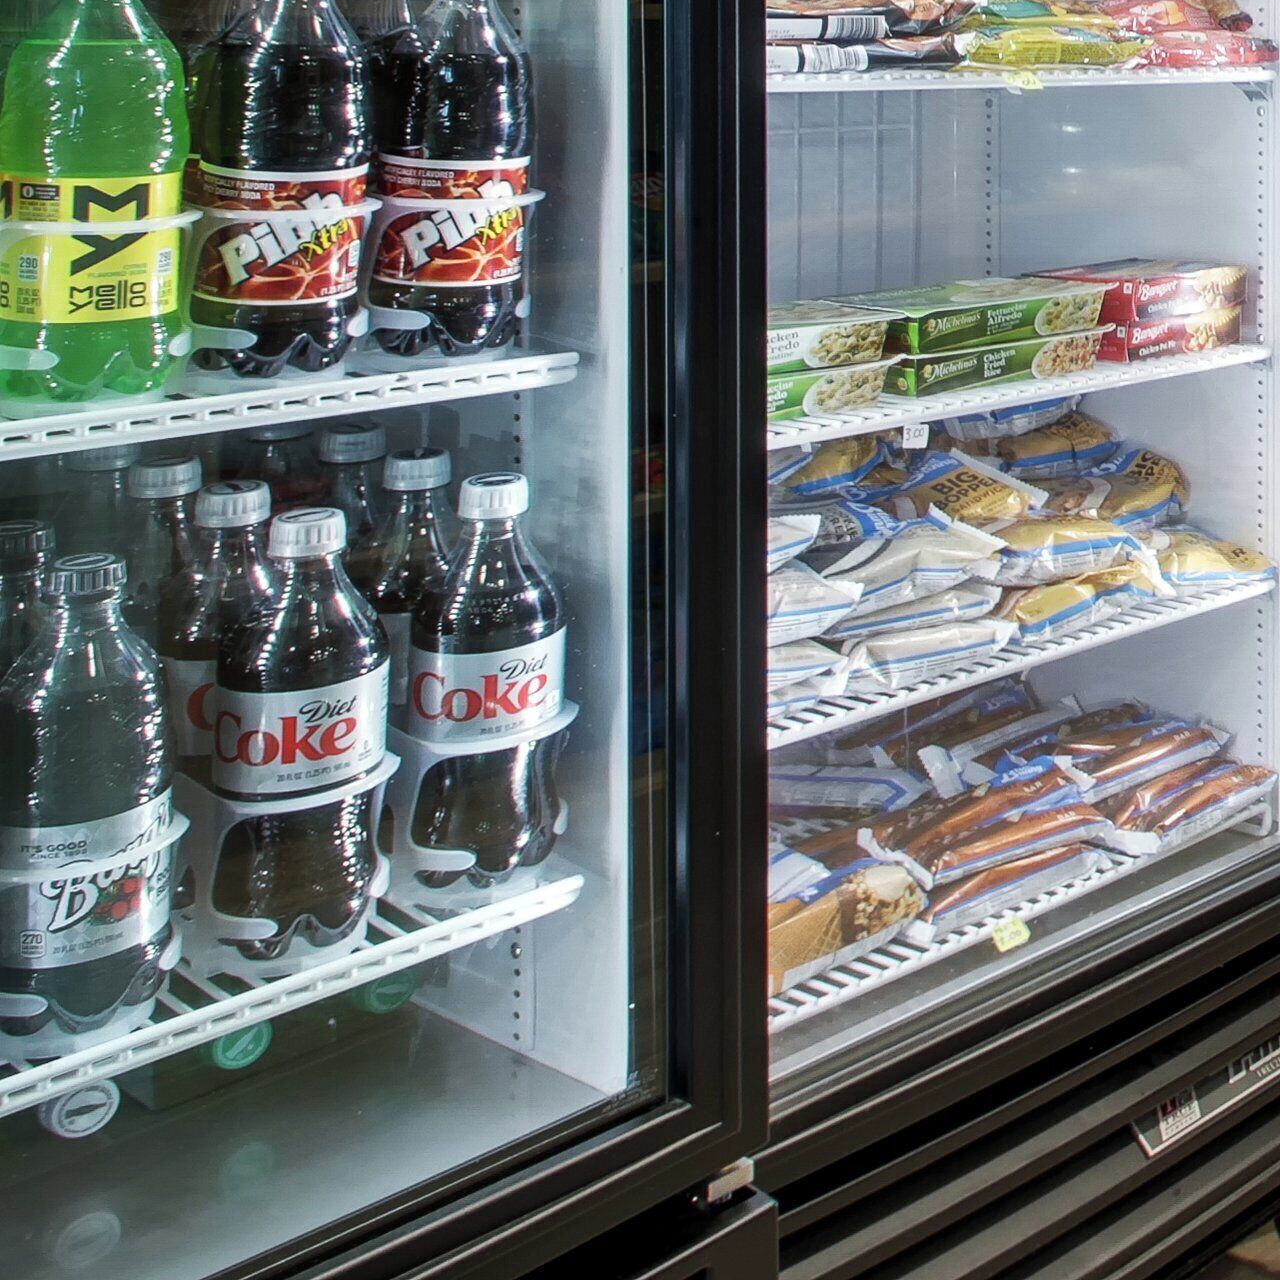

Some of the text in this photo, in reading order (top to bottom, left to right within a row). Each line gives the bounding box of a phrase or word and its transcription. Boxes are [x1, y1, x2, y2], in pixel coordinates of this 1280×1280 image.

[418, 170, 455, 179] FLAVORED
[236, 181, 276, 191] FLAVORED
[421, 178, 443, 188] SODA
[240, 190, 263, 200] SODA
[19, 256, 39, 270] 290
[1140, 280, 1178, 302] Banquet
[986, 302, 1028, 318] Fettuccine
[986, 310, 1024, 325] Alfredo
[934, 311, 982, 333] Michelina's
[1131, 322, 1169, 344] Banquet
[983, 348, 1017, 364] Chicken
[930, 357, 978, 379] Michelina's
[983, 358, 1007, 371] Fried
[983, 367, 1002, 379] Rice
[929, 470, 979, 495] BIG
[499, 652, 549, 681] Diet
[413, 672, 548, 723] Coke
[299, 695, 357, 723] Diet
[215, 711, 357, 767] Coke
[20, 840, 88, 854] IT'S GOOD
[29, 852, 61, 860] SINCE
[21, 933, 43, 945] 270
